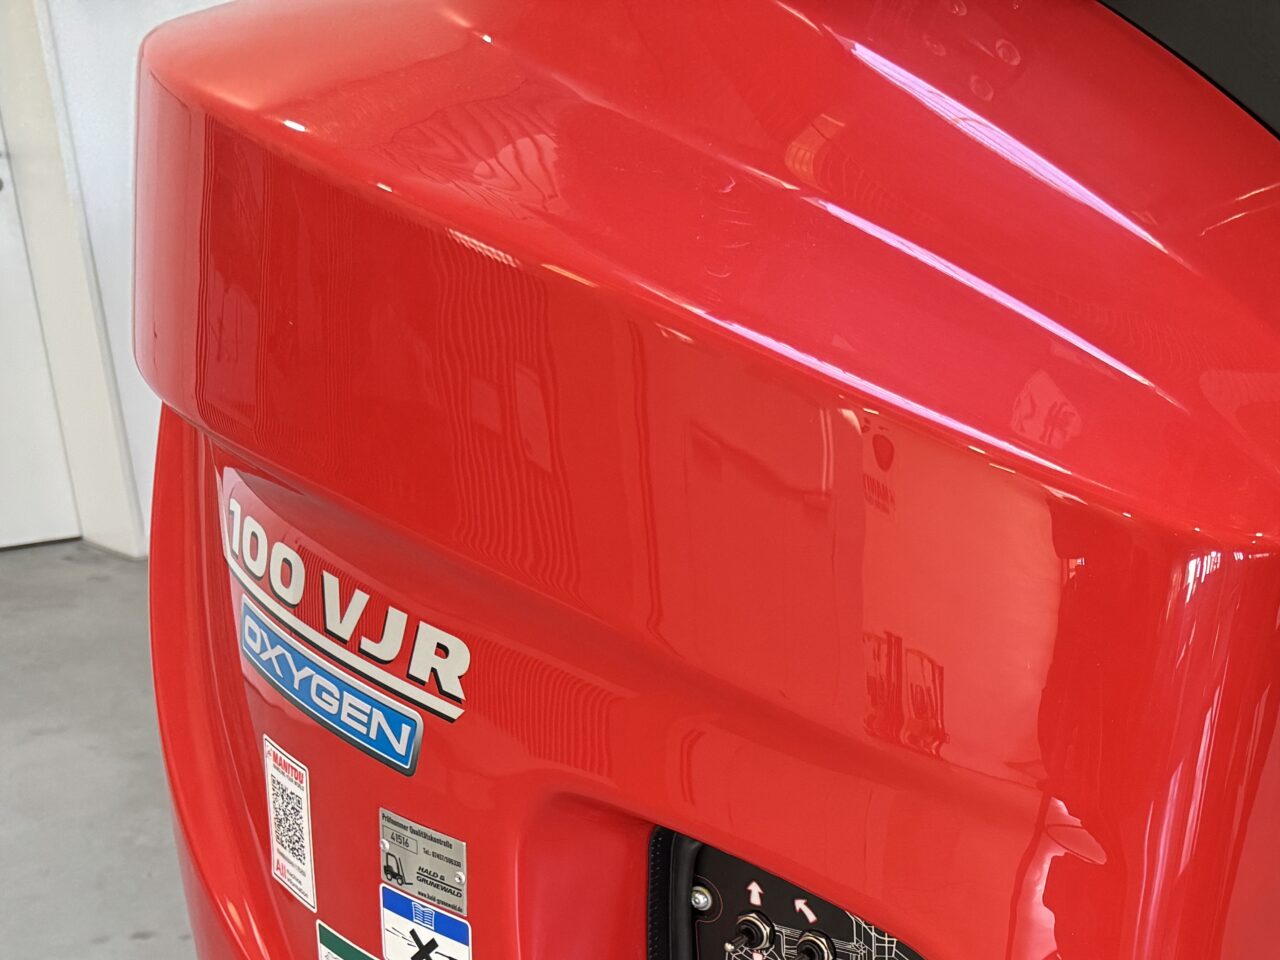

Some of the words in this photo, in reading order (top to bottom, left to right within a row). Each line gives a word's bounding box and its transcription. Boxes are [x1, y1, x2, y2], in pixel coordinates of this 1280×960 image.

[228, 497, 306, 609] 100
[321, 569, 471, 704] VJR
[243, 614, 412, 757] OXYGEN
[416, 876, 463, 898] GRUNEWALD
[418, 865, 440, 879] HALD
